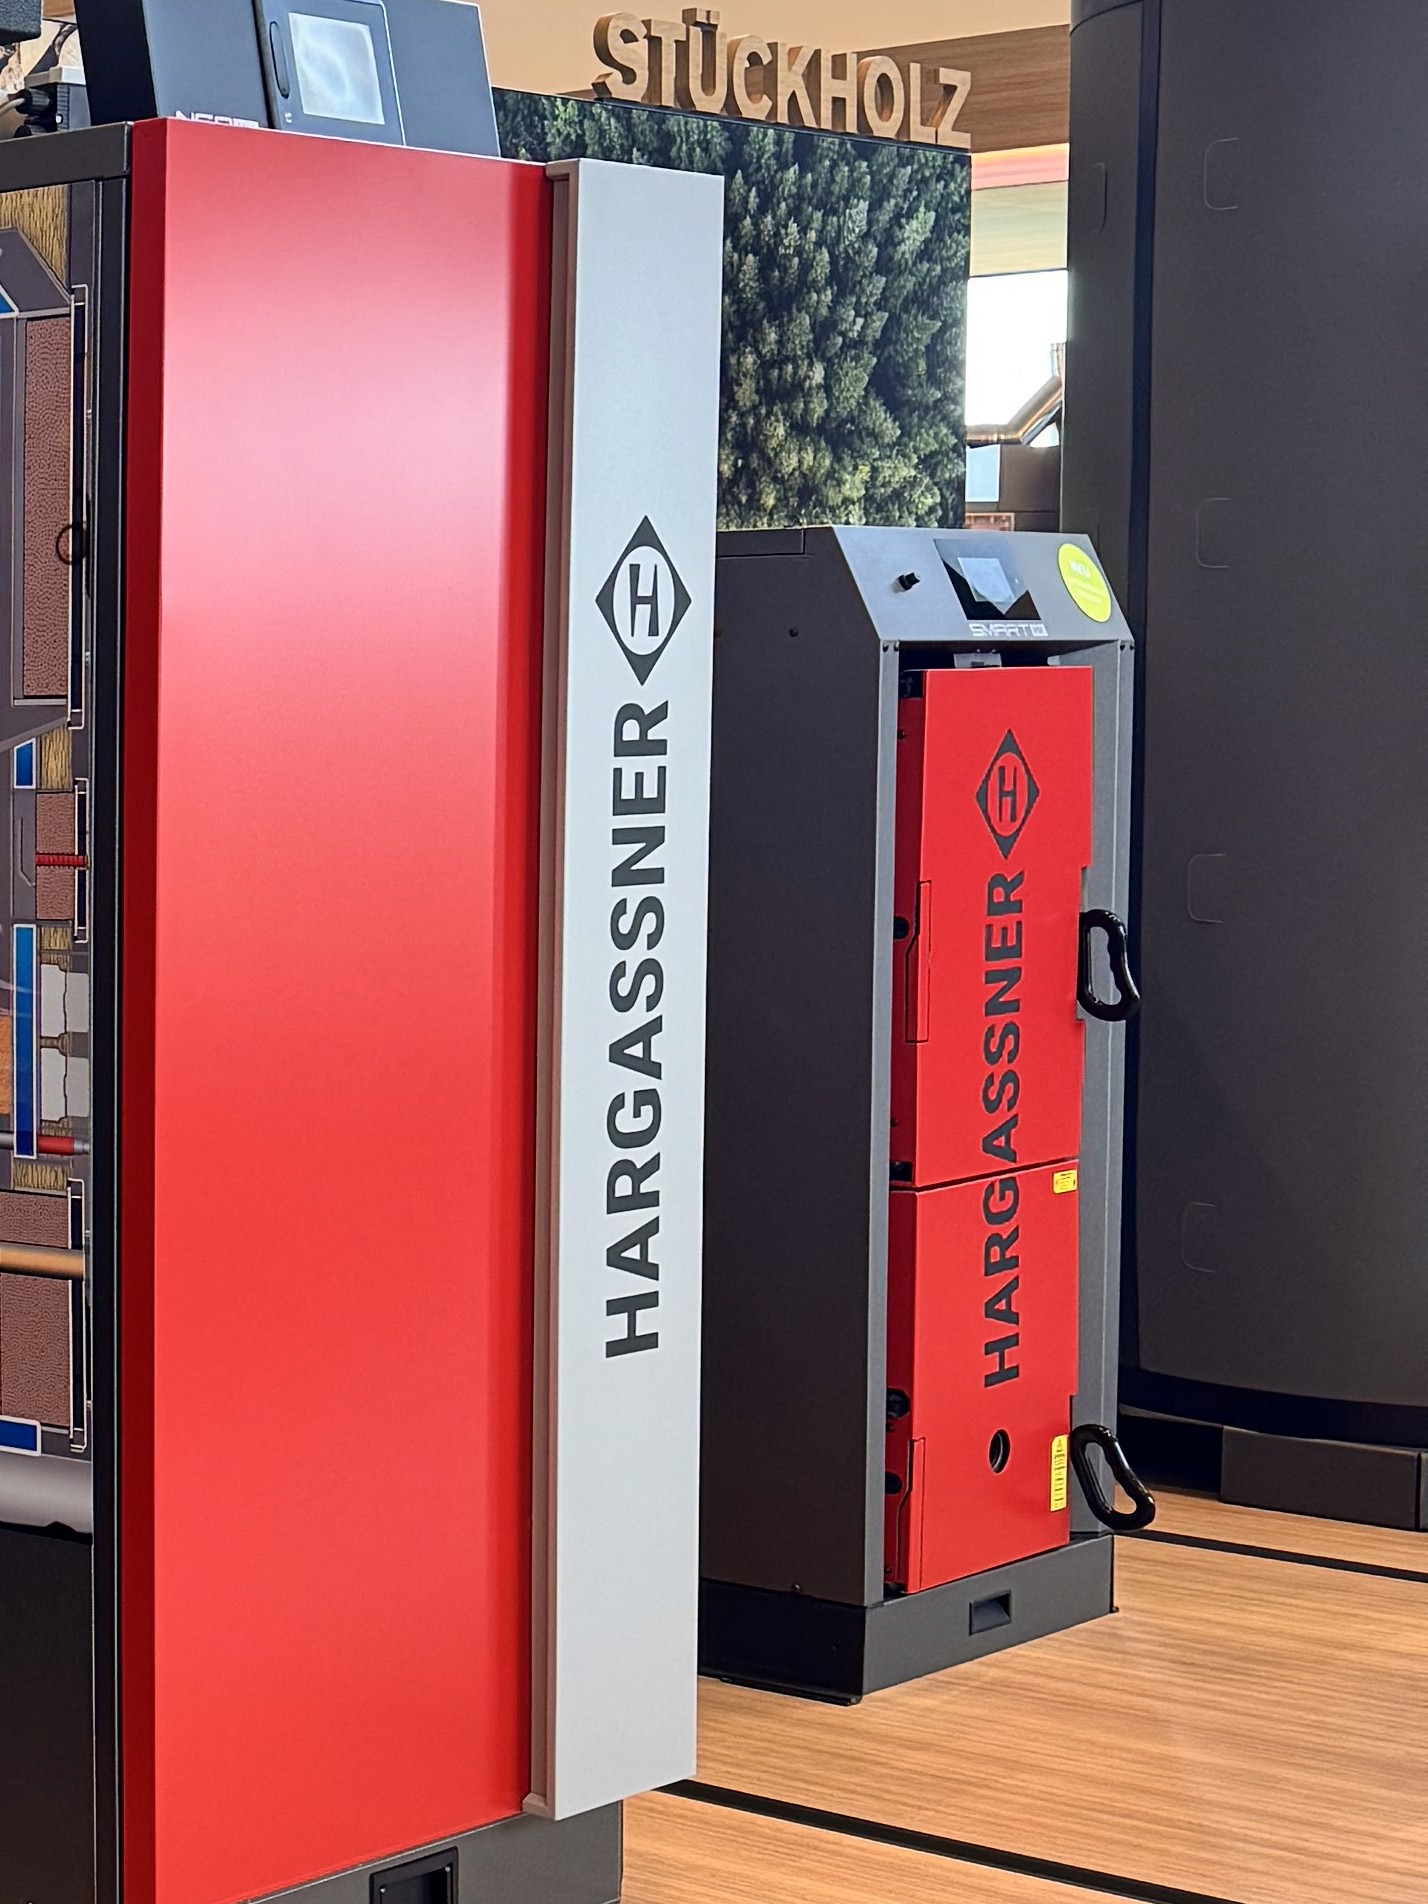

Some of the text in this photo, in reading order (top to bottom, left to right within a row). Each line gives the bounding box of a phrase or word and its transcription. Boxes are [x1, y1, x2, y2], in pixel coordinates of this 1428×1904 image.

[591, 7, 972, 149] STÜCKHOLZ
[605, 700, 669, 1359] HARGASSNER
[982, 870, 1025, 1387] HARGASSNER
